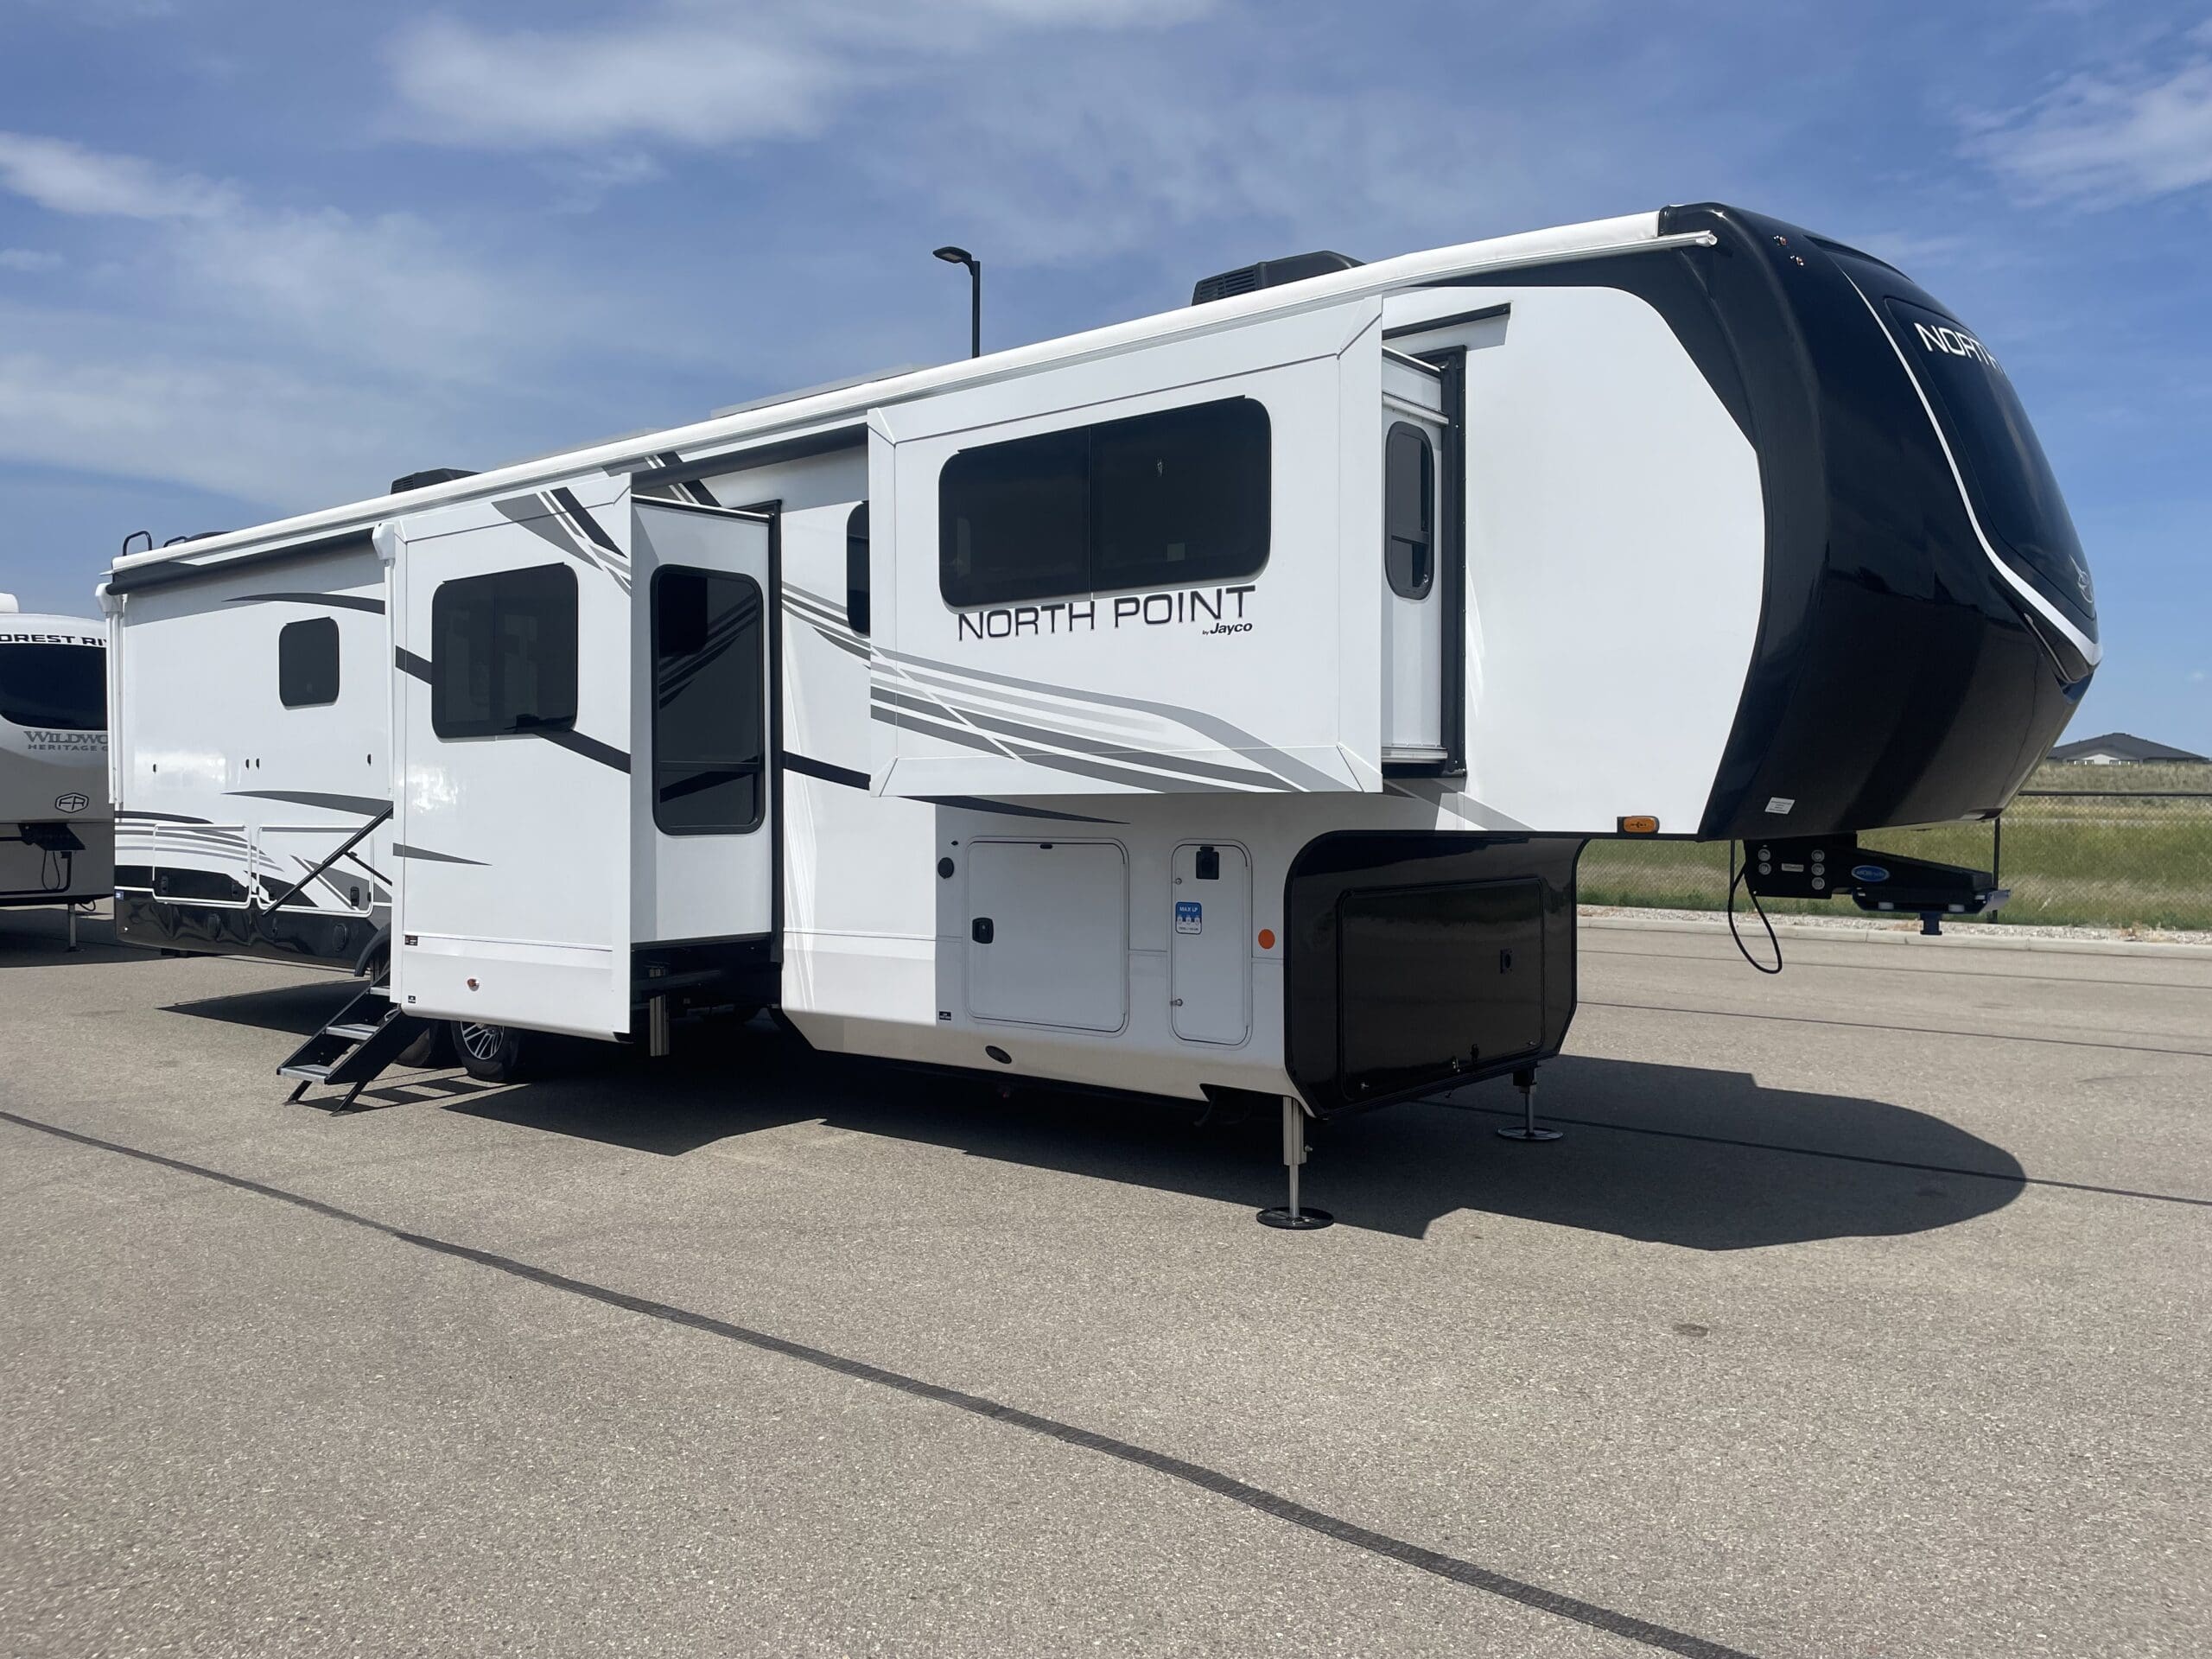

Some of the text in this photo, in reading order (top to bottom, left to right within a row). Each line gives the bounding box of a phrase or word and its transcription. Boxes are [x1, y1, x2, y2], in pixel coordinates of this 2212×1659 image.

[1914, 322, 2003, 374] NORTH
[958, 585, 1256, 641] NORTH POINT
[1210, 622, 1253, 635] Jayco
[0, 633, 75, 643] OREST
[23, 731, 108, 744] WILDWO
